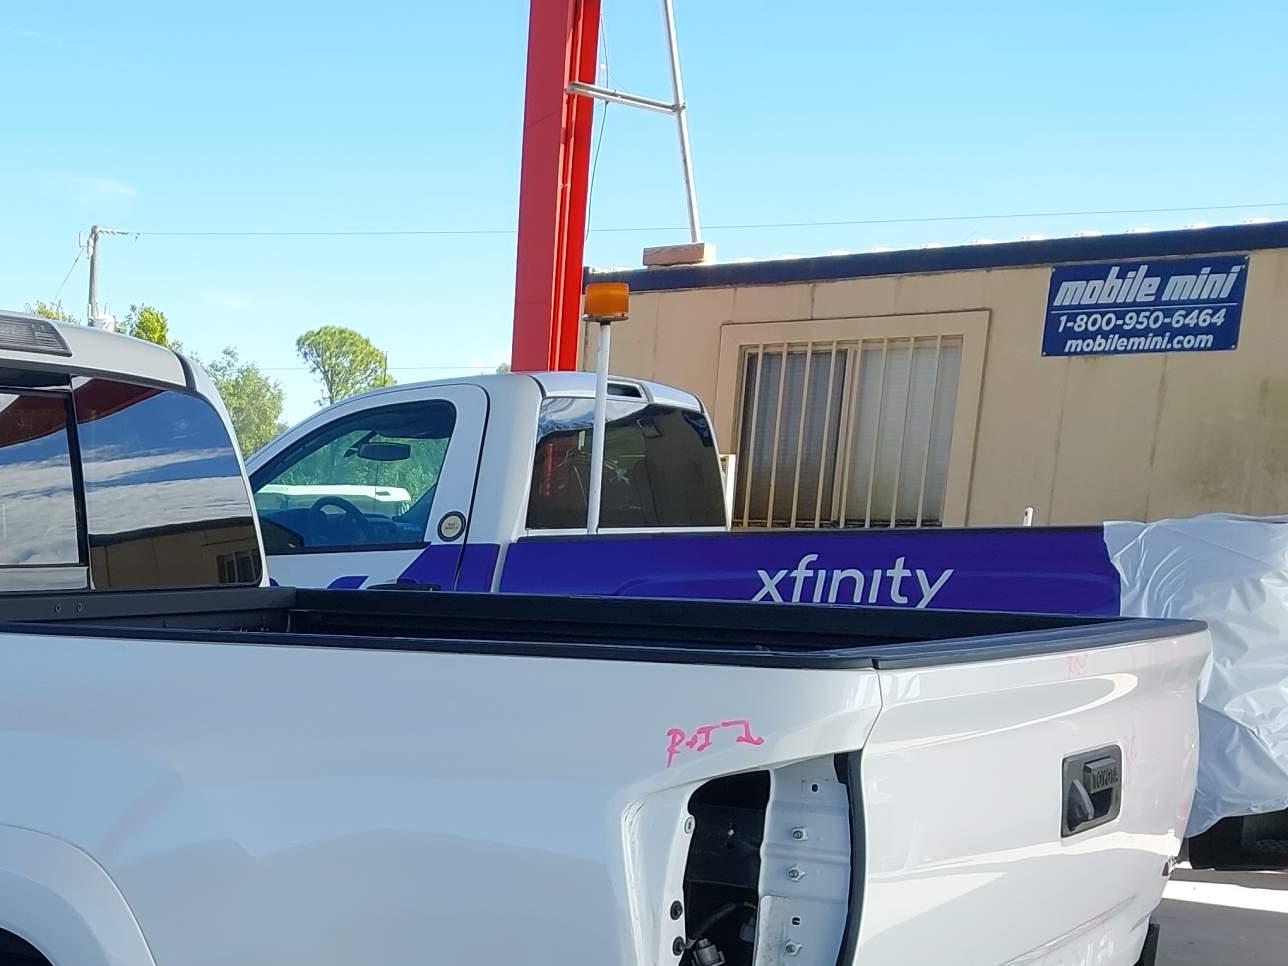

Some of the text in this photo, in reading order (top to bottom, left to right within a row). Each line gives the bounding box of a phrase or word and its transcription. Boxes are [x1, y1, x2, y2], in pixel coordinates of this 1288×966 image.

[1053, 265, 1241, 306] mobile mini
[1058, 308, 1226, 332] 1-800-950-6464
[1064, 332, 1214, 352] mobilemini.com
[751, 554, 954, 608] xfinity
